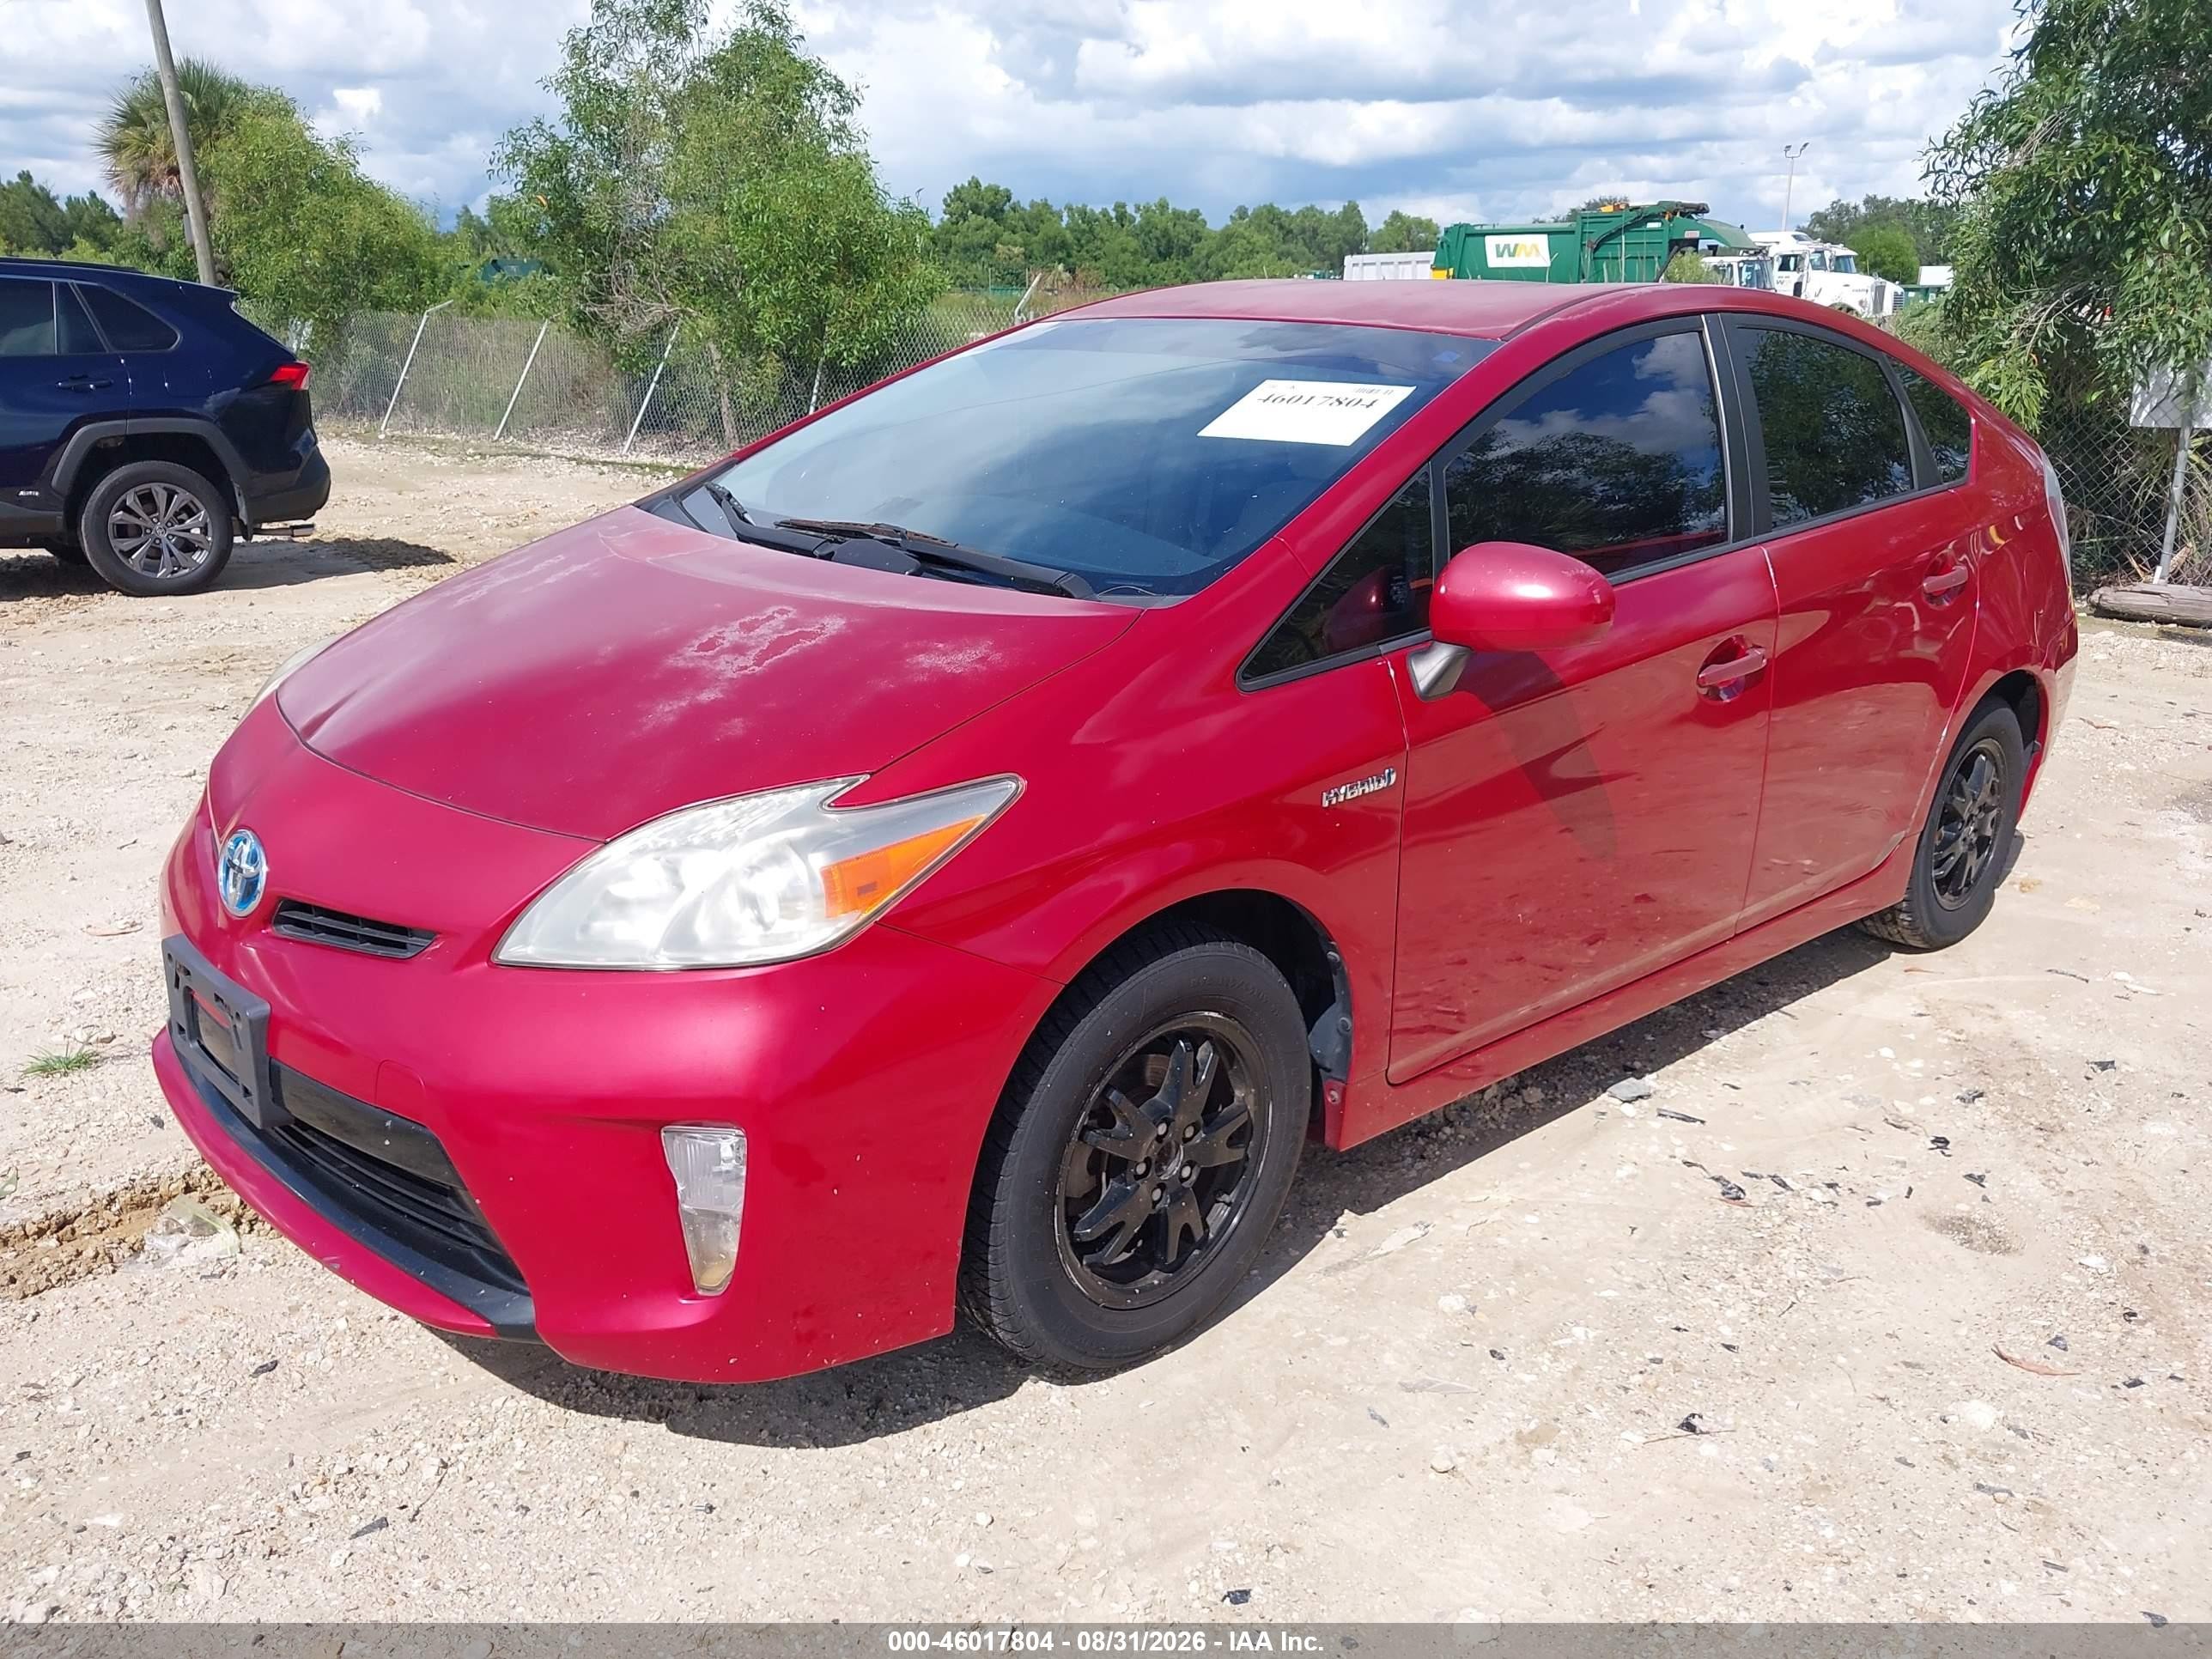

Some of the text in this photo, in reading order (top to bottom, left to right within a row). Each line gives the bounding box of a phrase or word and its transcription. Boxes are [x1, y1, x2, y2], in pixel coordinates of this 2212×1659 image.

[1495, 243, 1539, 258] WM
[1257, 392, 1380, 409] 46017804
[1322, 768, 1396, 807] HYBRID
